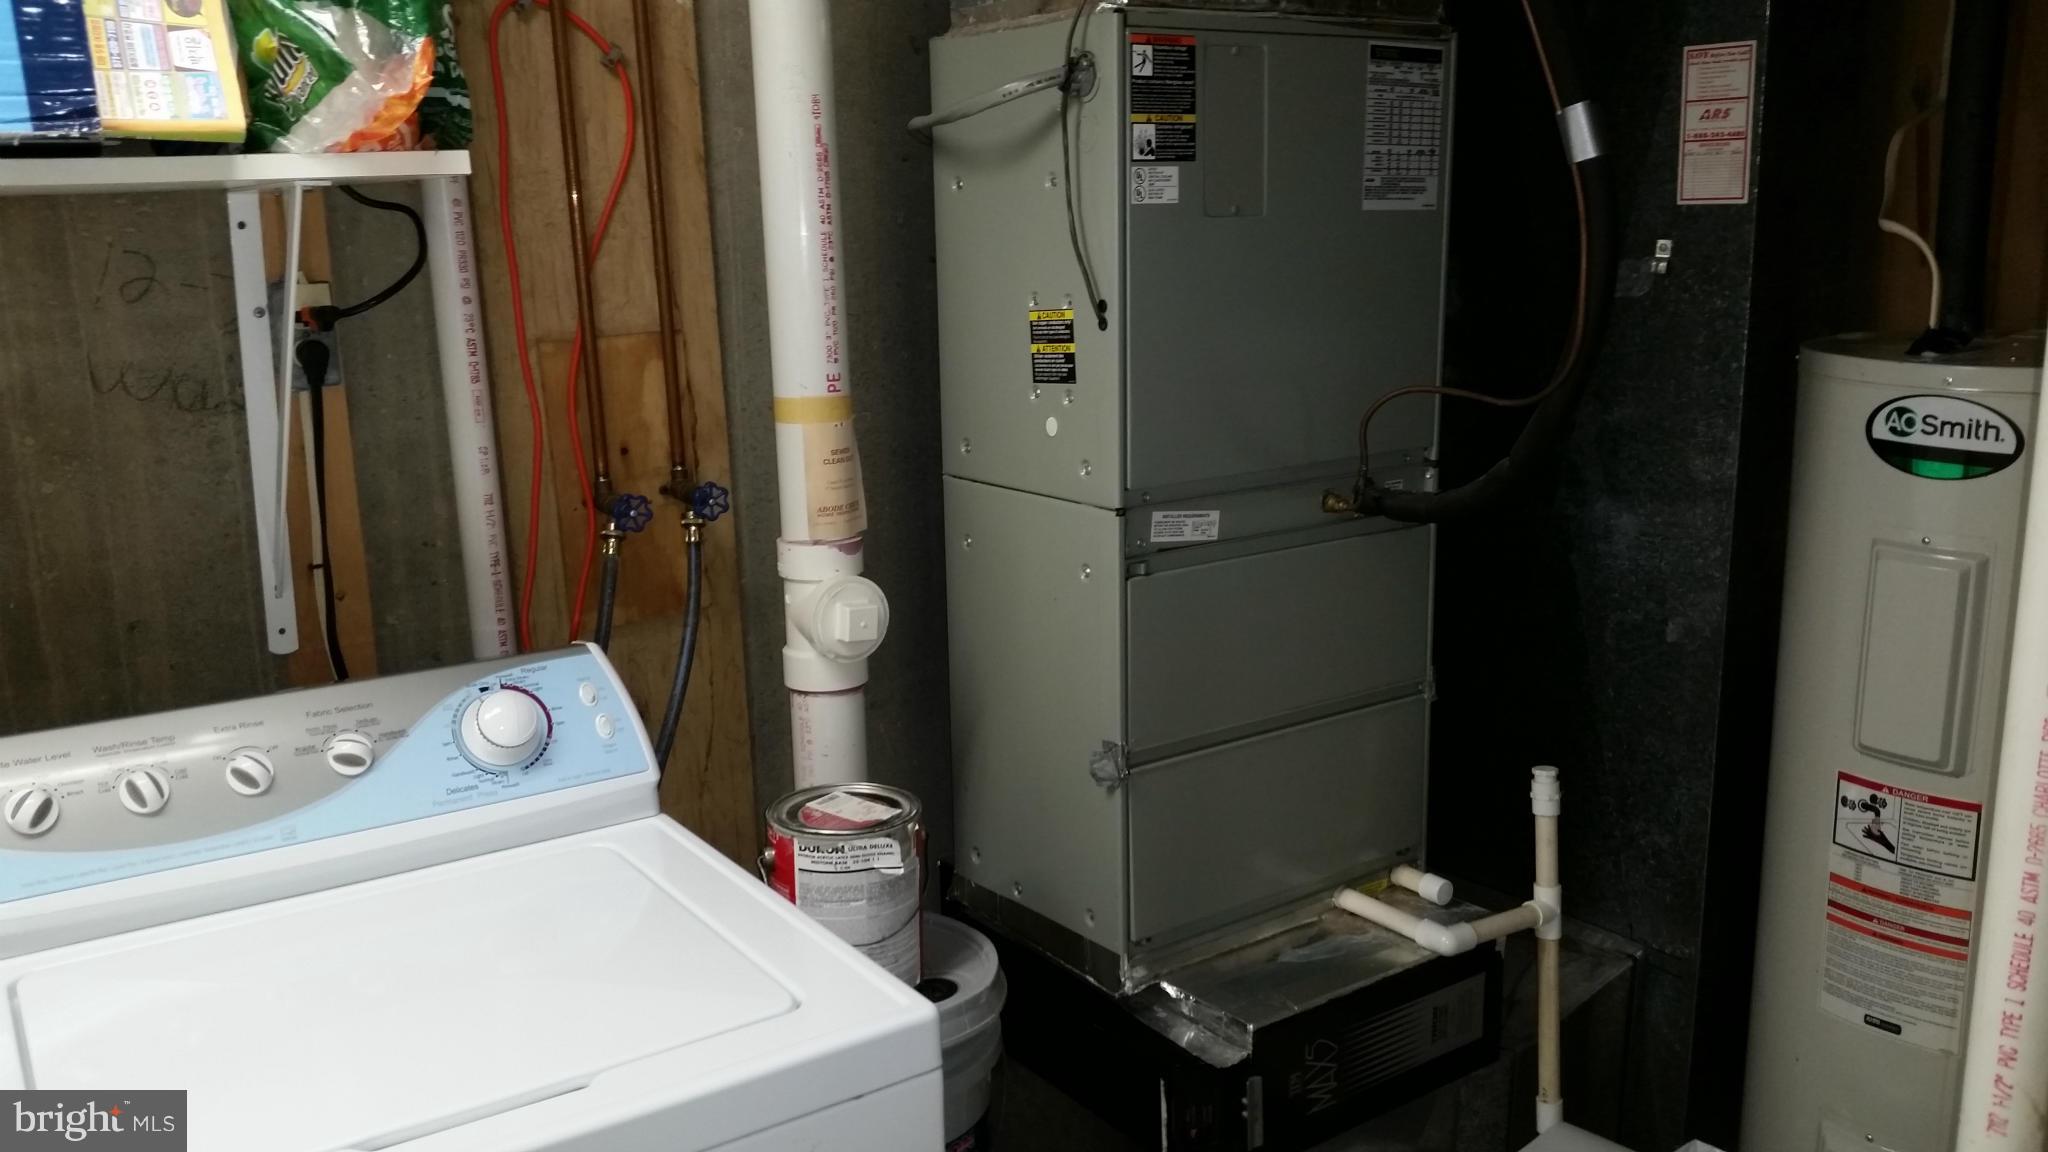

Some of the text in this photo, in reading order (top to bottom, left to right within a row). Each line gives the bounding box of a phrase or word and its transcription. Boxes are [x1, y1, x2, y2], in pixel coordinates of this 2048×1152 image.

[465, 337, 479, 357] ASTM
[825, 372, 842, 393] PE
[520, 664, 548, 675] Regular
[334, 702, 374, 714] Selection
[445, 783, 479, 796] Delicates
[1892, 788, 1929, 803] DANGER
[2019, 871, 2040, 904] ASTM
[2016, 910, 2036, 926] 40
[2006, 933, 2033, 991] SCHEDULE
[2000, 1010, 2023, 1039] TYPE
